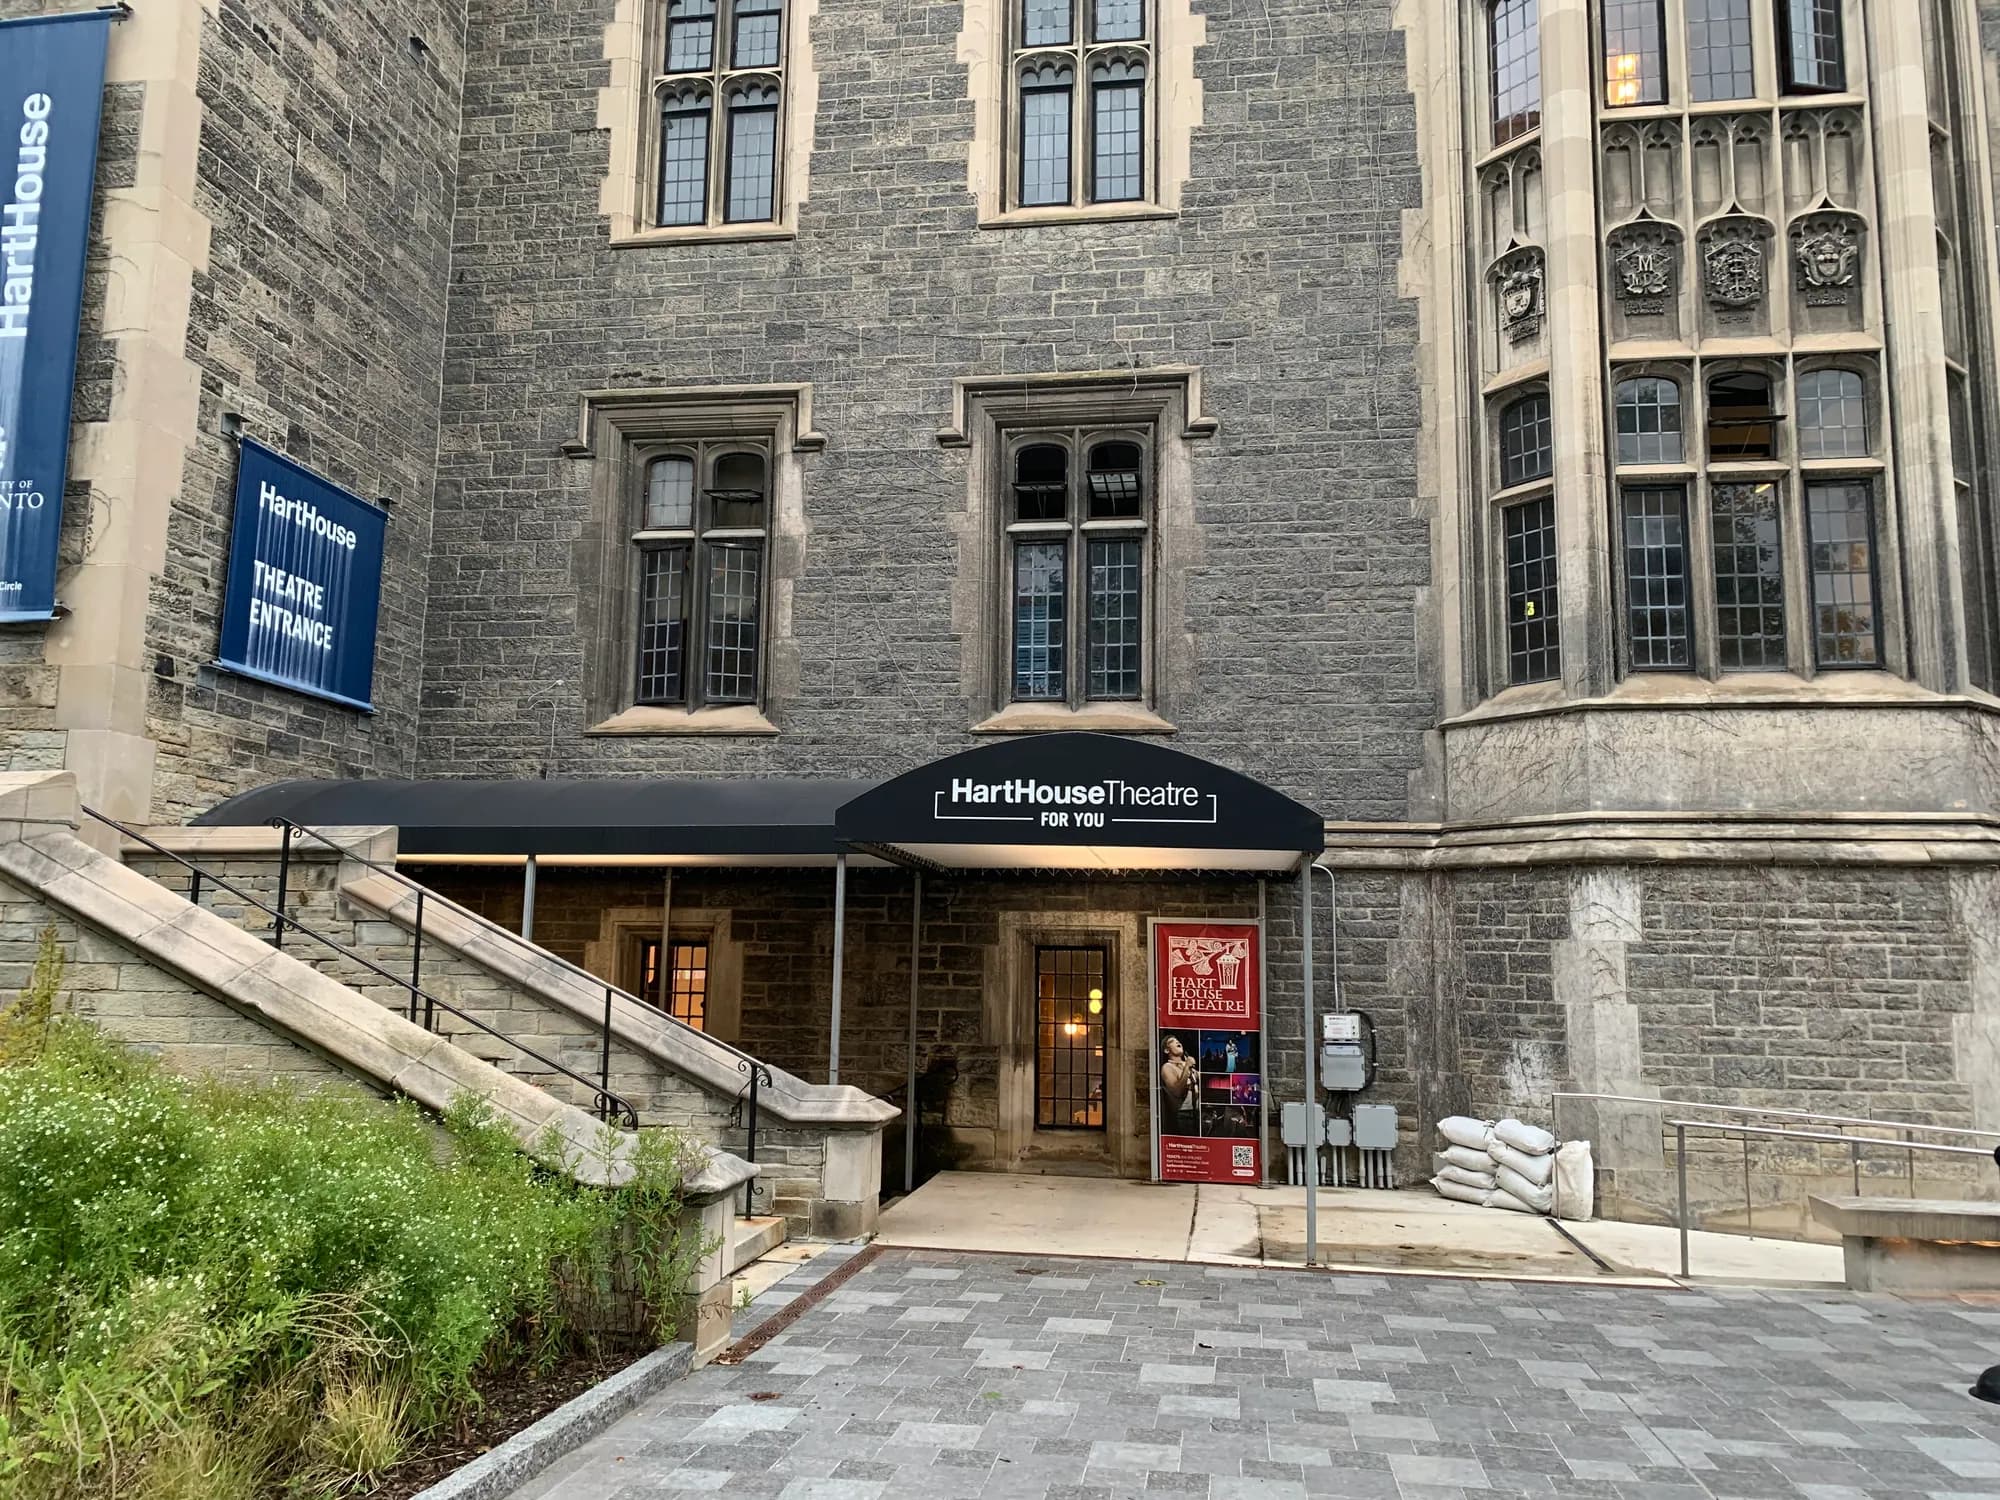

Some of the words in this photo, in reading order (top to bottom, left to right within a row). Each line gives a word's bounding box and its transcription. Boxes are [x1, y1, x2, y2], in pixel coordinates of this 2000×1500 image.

[0, 93, 51, 337] HartHouse
[19, 479, 33, 489] OF
[259, 480, 357, 549] HartHouse
[254, 560, 324, 610] THEATRE
[250, 597, 333, 650] ENTRANCE
[1041, 812, 1069, 827] FOR
[1074, 812, 1105, 828] YOU
[1172, 977, 1217, 989] HART
[1172, 988, 1223, 1000] HOUSE
[1172, 999, 1245, 1011] THEATRE
